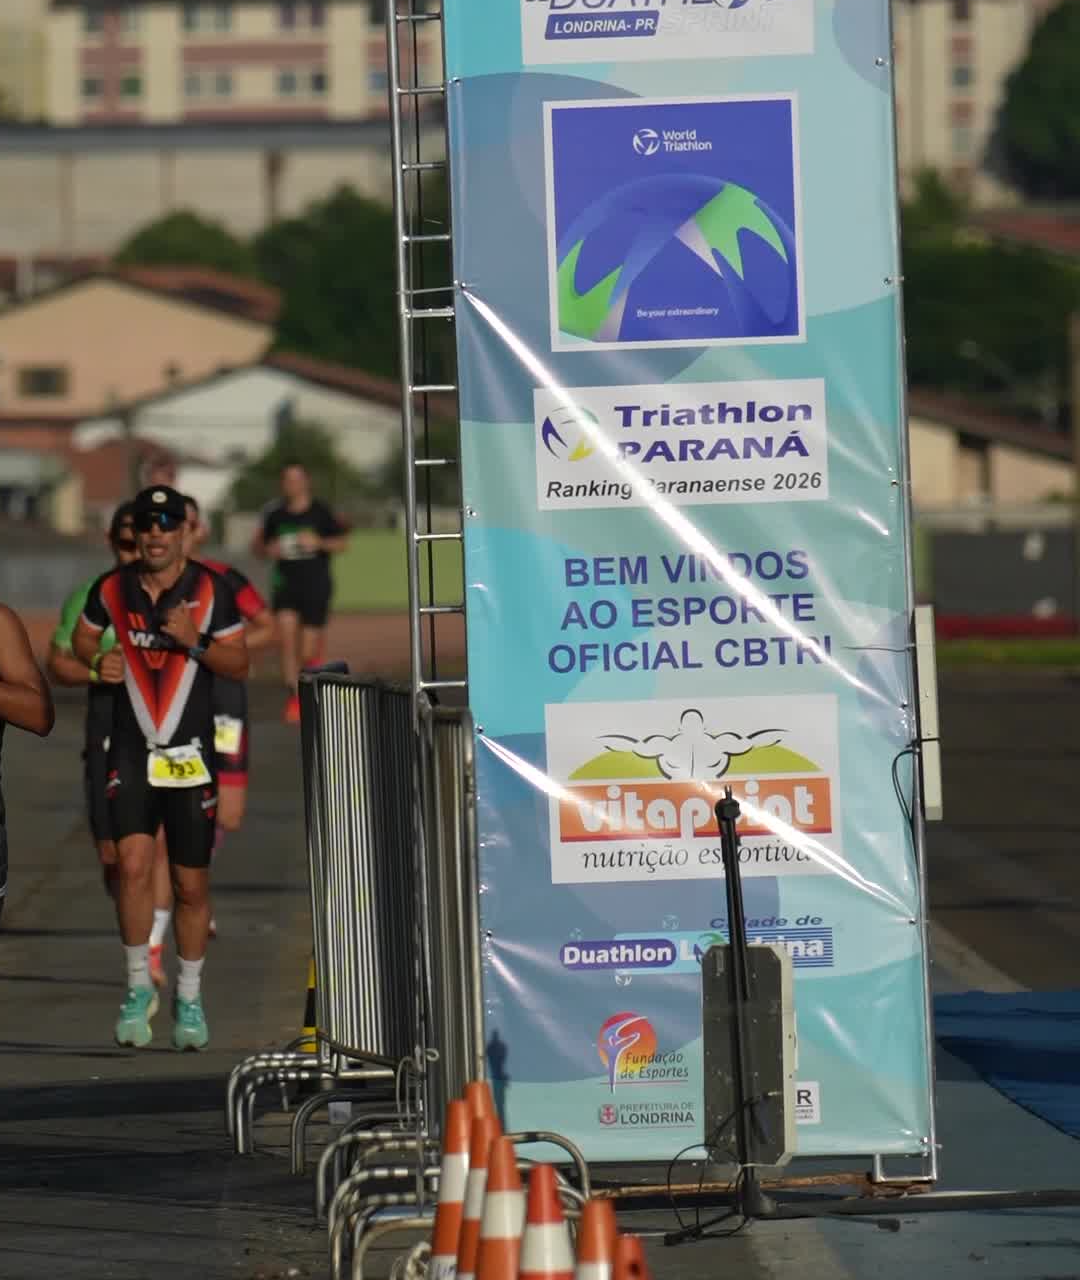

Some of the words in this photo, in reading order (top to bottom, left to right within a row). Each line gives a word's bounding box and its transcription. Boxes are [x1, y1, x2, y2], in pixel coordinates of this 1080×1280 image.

[662, 129, 697, 140] World
[663, 139, 712, 152] Triathlon
[614, 401, 812, 427] Triathlon
[617, 430, 810, 463] PARANÁ
[546, 480, 632, 500] Ranking
[773, 472, 822, 490] 2026
[564, 555, 648, 587] BEM
[560, 600, 618, 631] AO
[631, 593, 816, 628] ESPORTE
[549, 640, 703, 673] OFICIAL
[715, 635, 832, 667] CBTRI
[578, 777, 814, 838] vitapint
[582, 844, 688, 873] nutrição
[698, 839, 812, 871] esortiva
[710, 915, 788, 929] Cade
[795, 915, 823, 926] de
[563, 944, 672, 964] Duathlon
[624, 1051, 684, 1065] Fundação
[620, 1067, 635, 1079] de
[639, 1065, 689, 1080] Esportes
[619, 1103, 679, 1112] PREFEITURA
[680, 1102, 694, 1110] DE
[620, 1111, 695, 1125] LONDRINA
